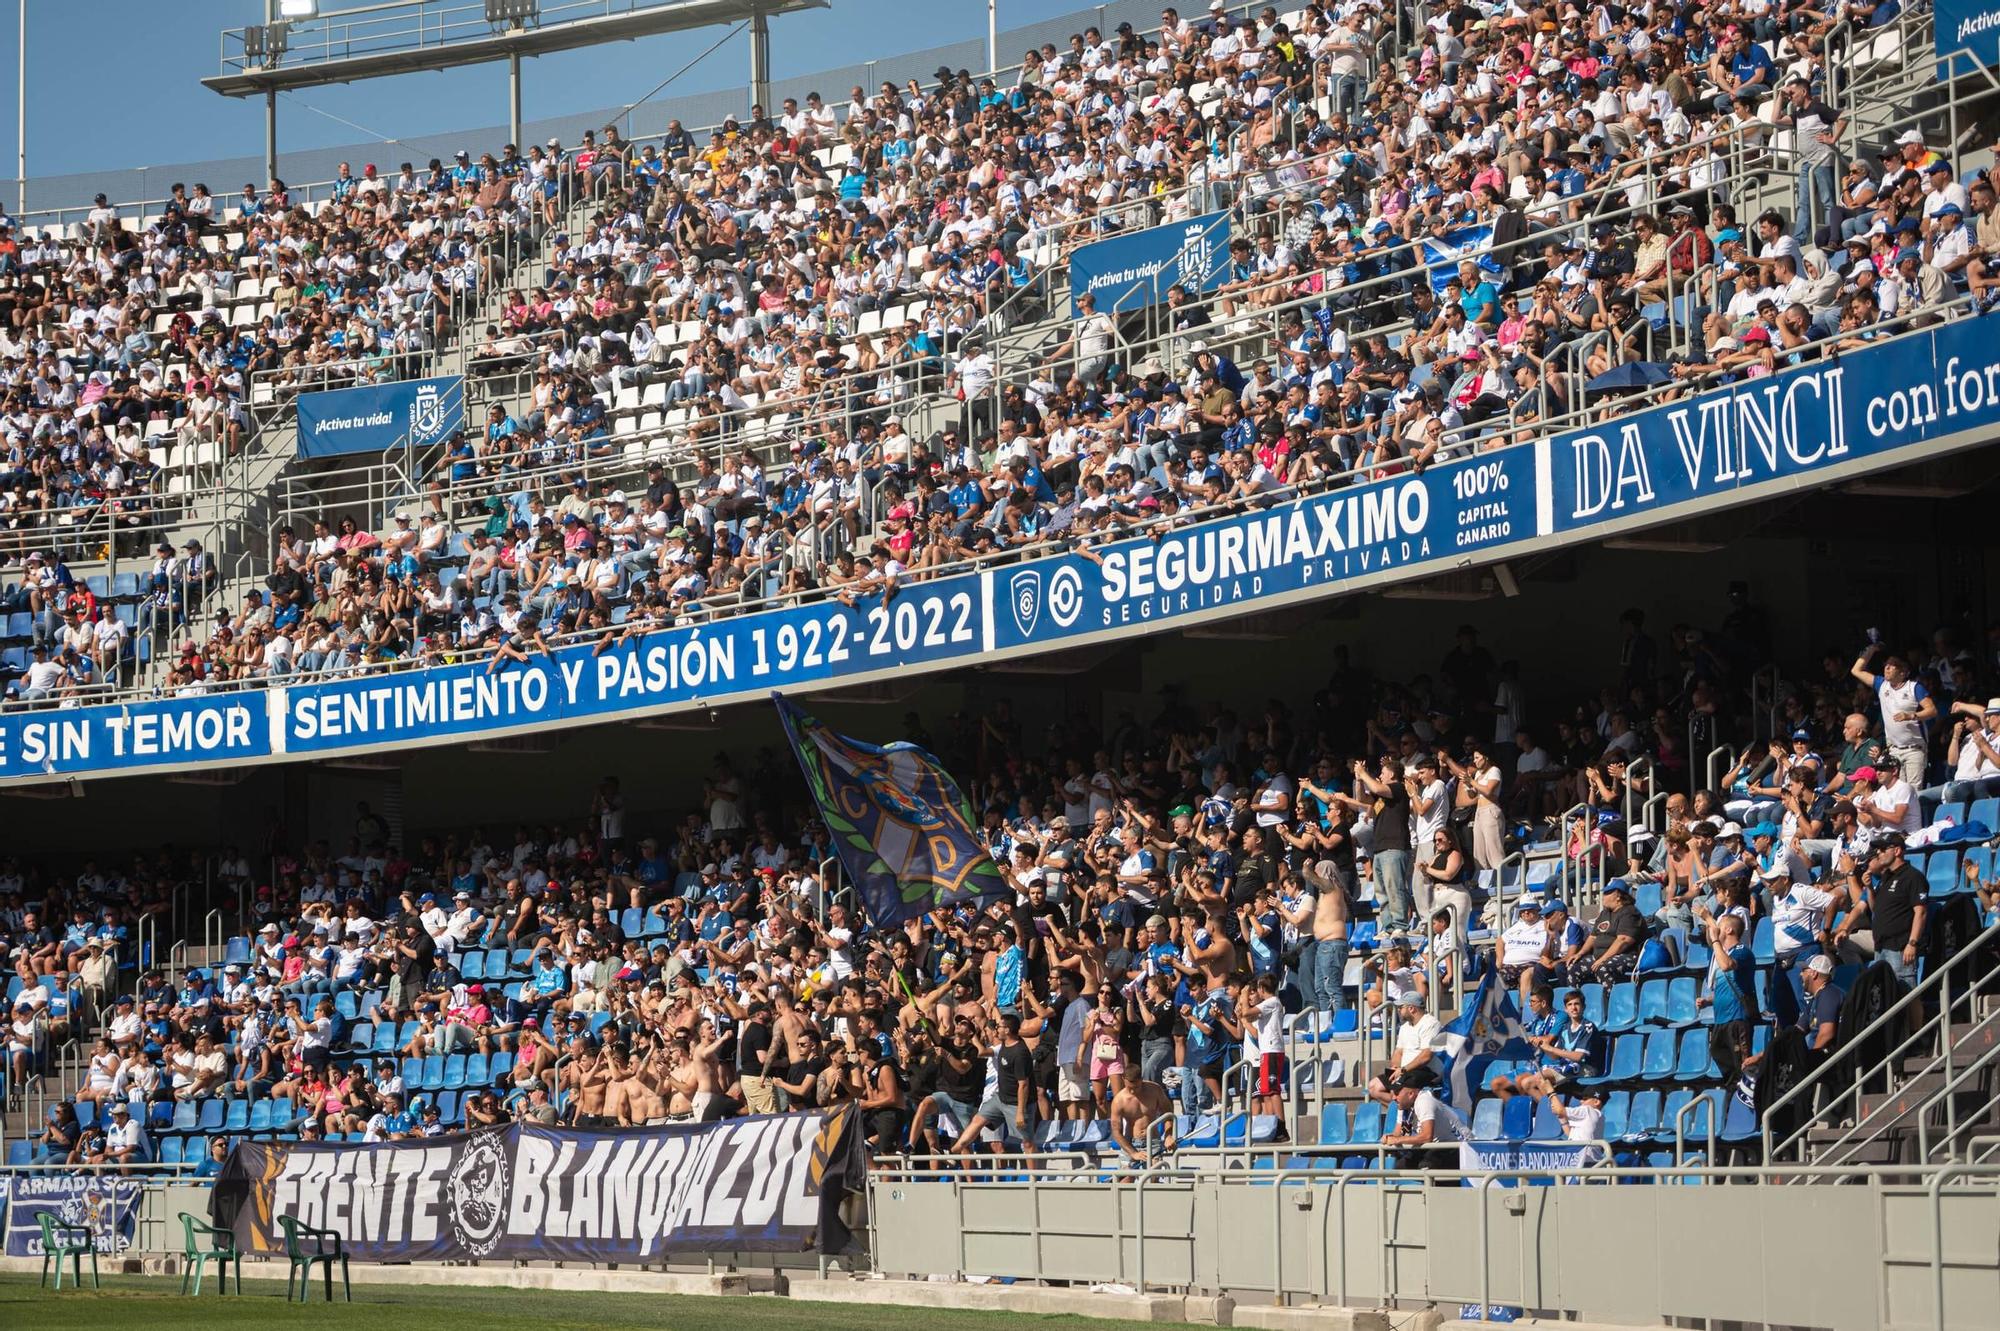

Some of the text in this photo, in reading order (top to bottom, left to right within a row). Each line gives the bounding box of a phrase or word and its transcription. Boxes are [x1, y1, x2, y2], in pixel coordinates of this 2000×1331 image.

[1088, 270, 1122, 292] ¡Activa
[1123, 269, 1135, 281] tu
[315, 411, 393, 436] ¡Activa tu vida!
[1572, 423, 1655, 519] DA
[1667, 367, 1849, 491] VINCI
[1867, 383, 1937, 437] con
[1453, 460, 1509, 500] 100%
[1456, 521, 1511, 547] CANARIO
[1457, 501, 1509, 526] CAPITAL
[1101, 479, 1429, 602] SEGURMÁXIMO
[1103, 536, 1431, 625] SEGURIDAD PRIVADA
[294, 592, 973, 739] SENTIMIENTO Y PASIÓN 1922-2022
[21, 719, 90, 763] SIN
[106, 707, 251, 756] TEMOR
[18, 1176, 99, 1196] ARMADA
[272, 1147, 452, 1241] FRENTE
